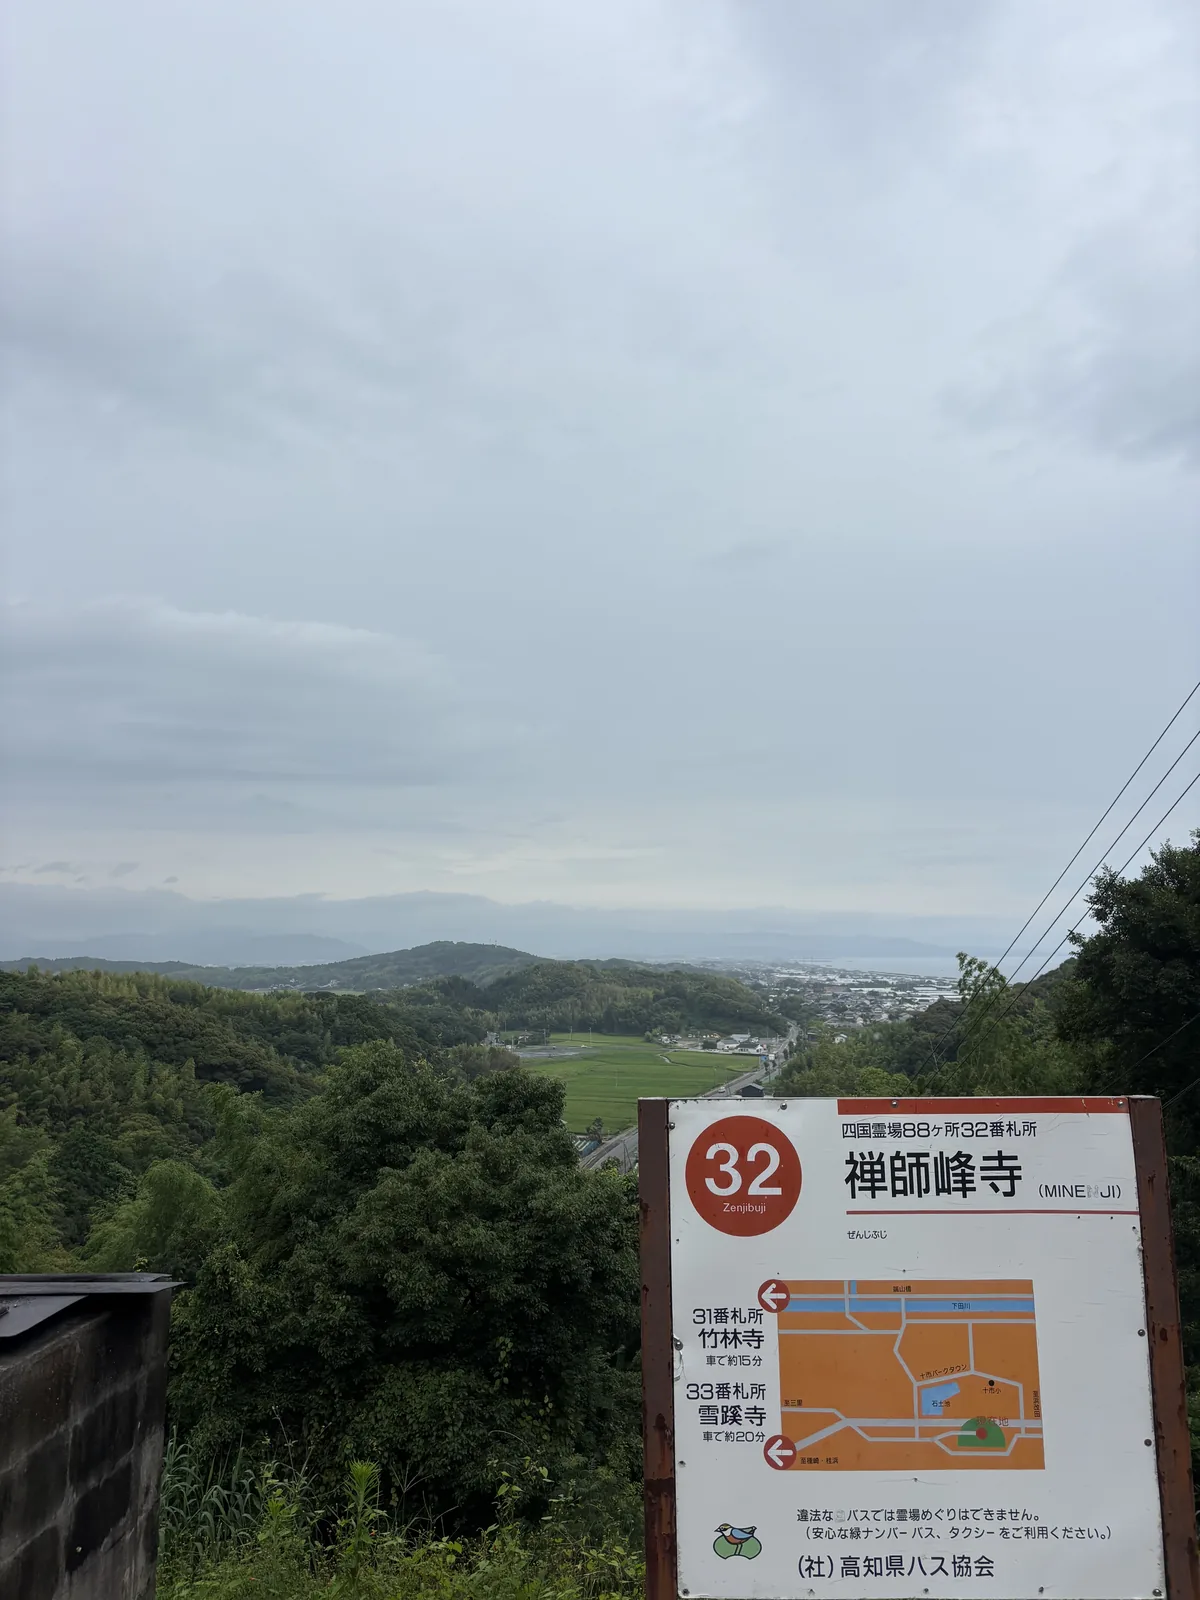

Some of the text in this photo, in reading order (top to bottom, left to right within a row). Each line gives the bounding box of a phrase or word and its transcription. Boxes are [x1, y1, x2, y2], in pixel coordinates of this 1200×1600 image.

[704, 1142, 782, 1197] 32
[844, 1150, 1022, 1199] 禅師峰寺
[723, 1202, 766, 1214] Zenjibuji
[847, 1230, 887, 1240] ぜんじぶじ
[951, 1301, 971, 1310] 下田川
[692, 1307, 764, 1325] 31番札所
[698, 1328, 764, 1349] 竹林寺
[706, 1354, 762, 1366] 車で約15分
[686, 1382, 766, 1400] 33番札所
[698, 1404, 766, 1427] 雪蹊寺
[703, 1431, 766, 1443] 車で約20分
